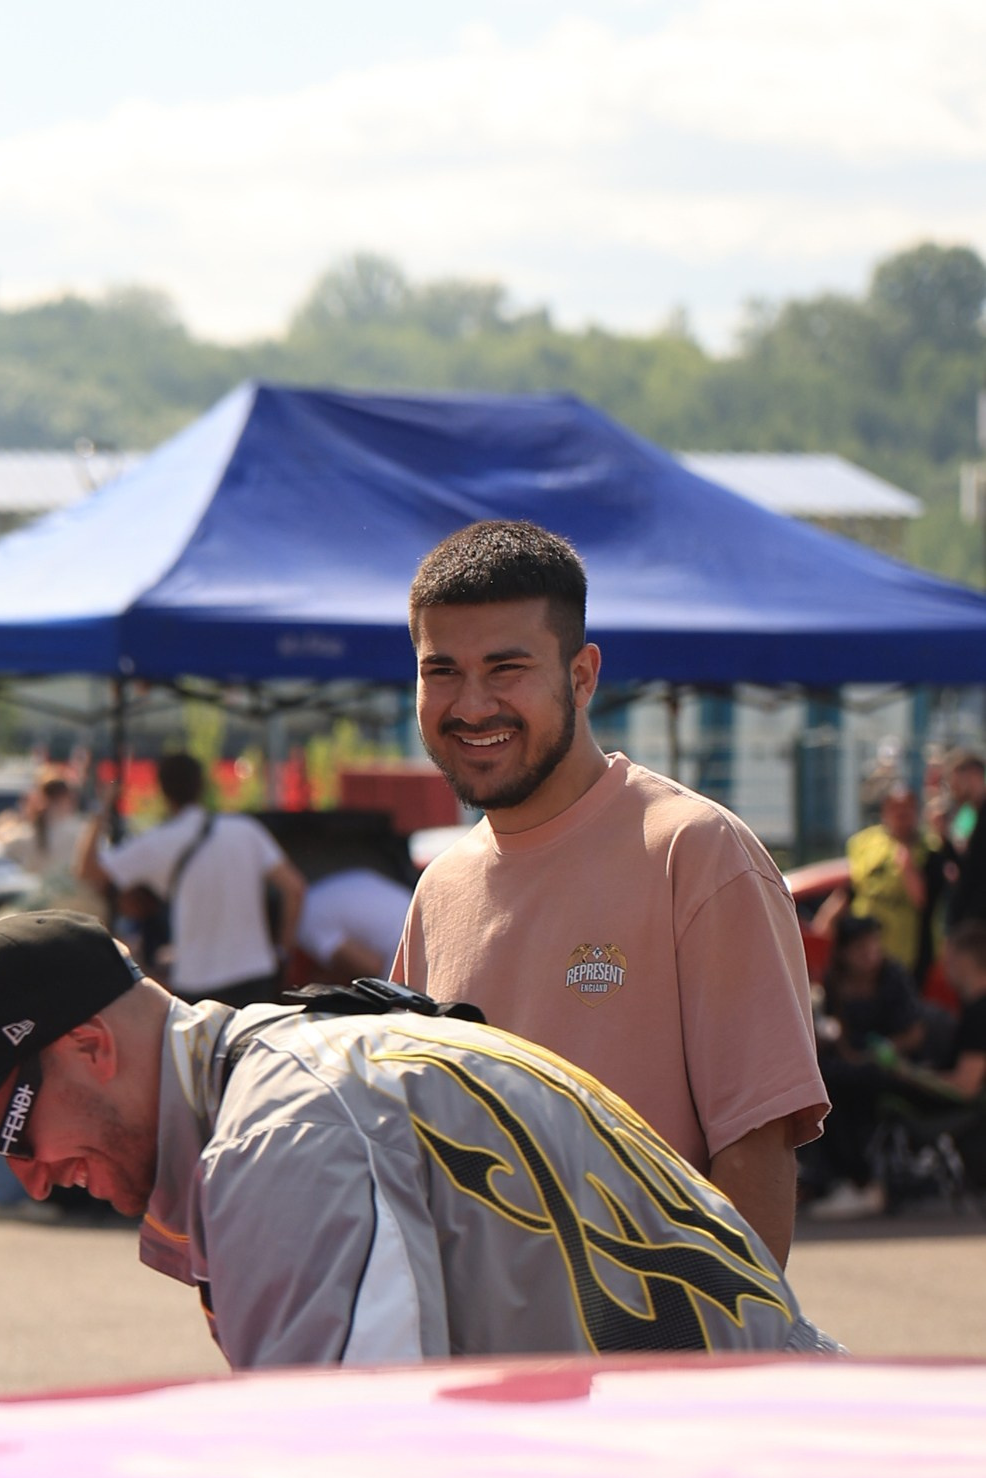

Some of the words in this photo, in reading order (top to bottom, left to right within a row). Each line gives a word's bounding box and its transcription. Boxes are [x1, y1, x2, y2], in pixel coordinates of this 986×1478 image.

[566, 962, 626, 987] REPRESENT
[581, 983, 608, 993] ENGLAND
[1, 1083, 35, 1143] FENDI
